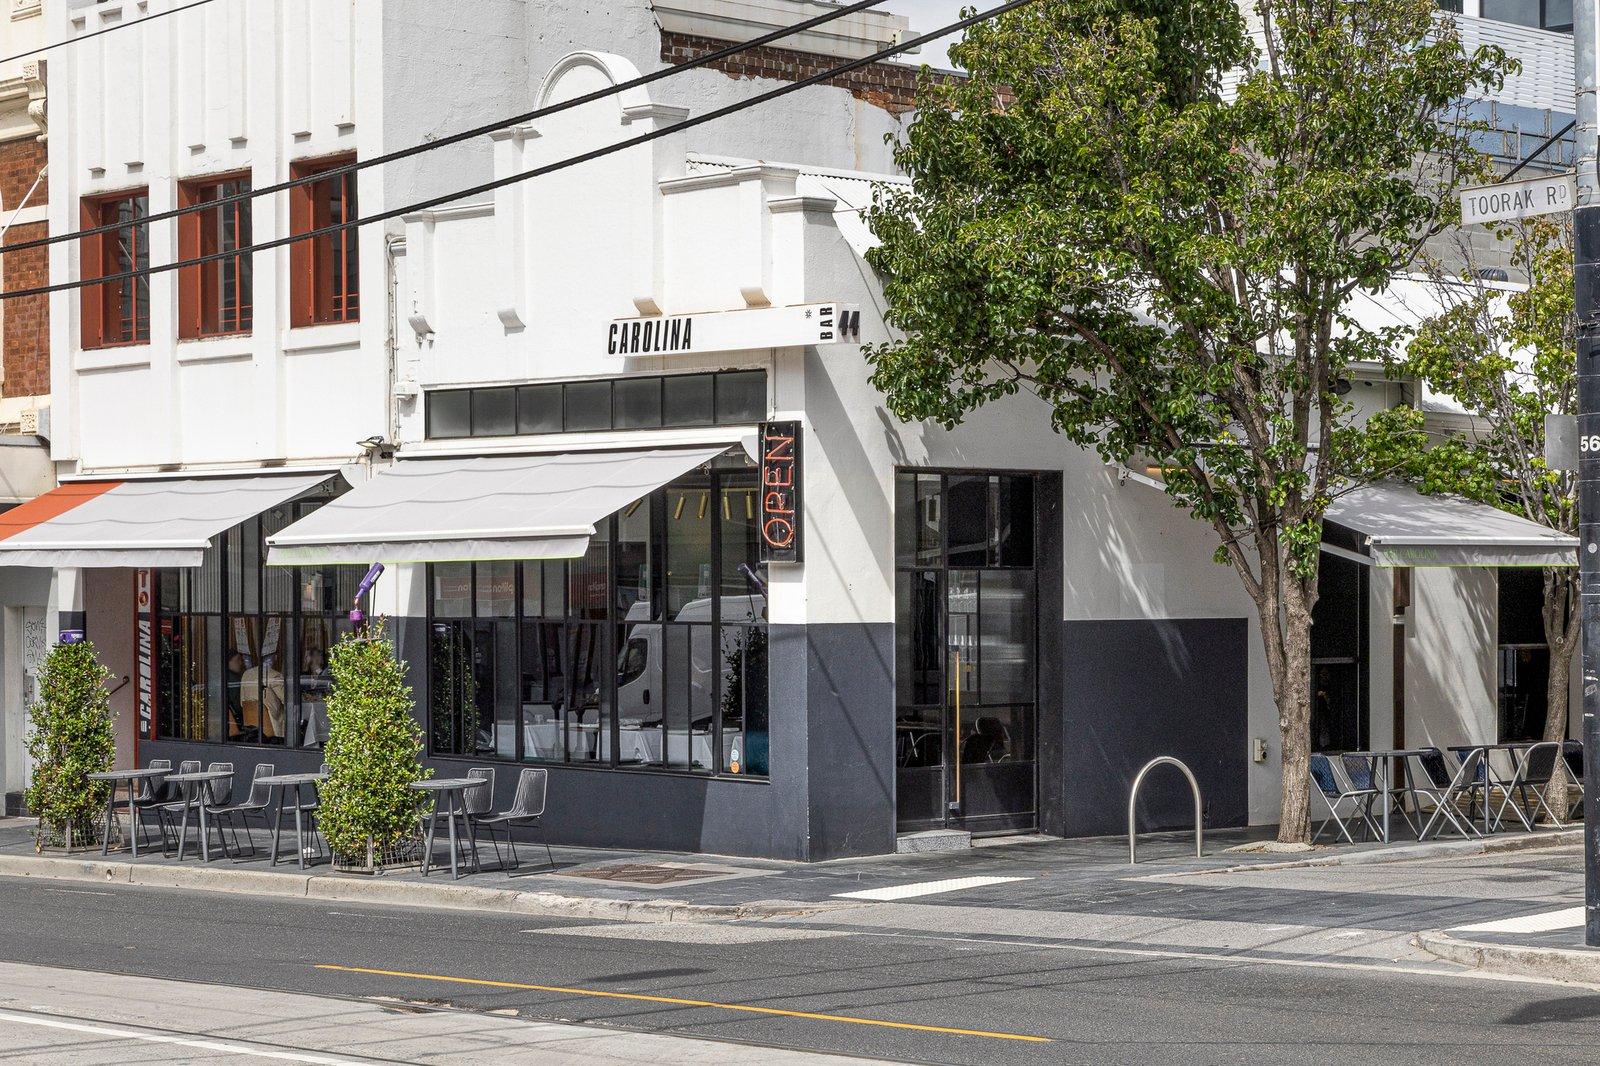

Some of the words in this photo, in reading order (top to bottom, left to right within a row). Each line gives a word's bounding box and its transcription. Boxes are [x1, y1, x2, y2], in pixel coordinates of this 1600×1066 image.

[1468, 189, 1534, 216] TOORAK
[607, 317, 692, 355] CAROLINA
[819, 306, 833, 340] BAR
[838, 310, 860, 337] 44
[1580, 435, 1600, 452] 56
[764, 435, 795, 547] OPEN
[139, 620, 152, 720] CAROLINA
